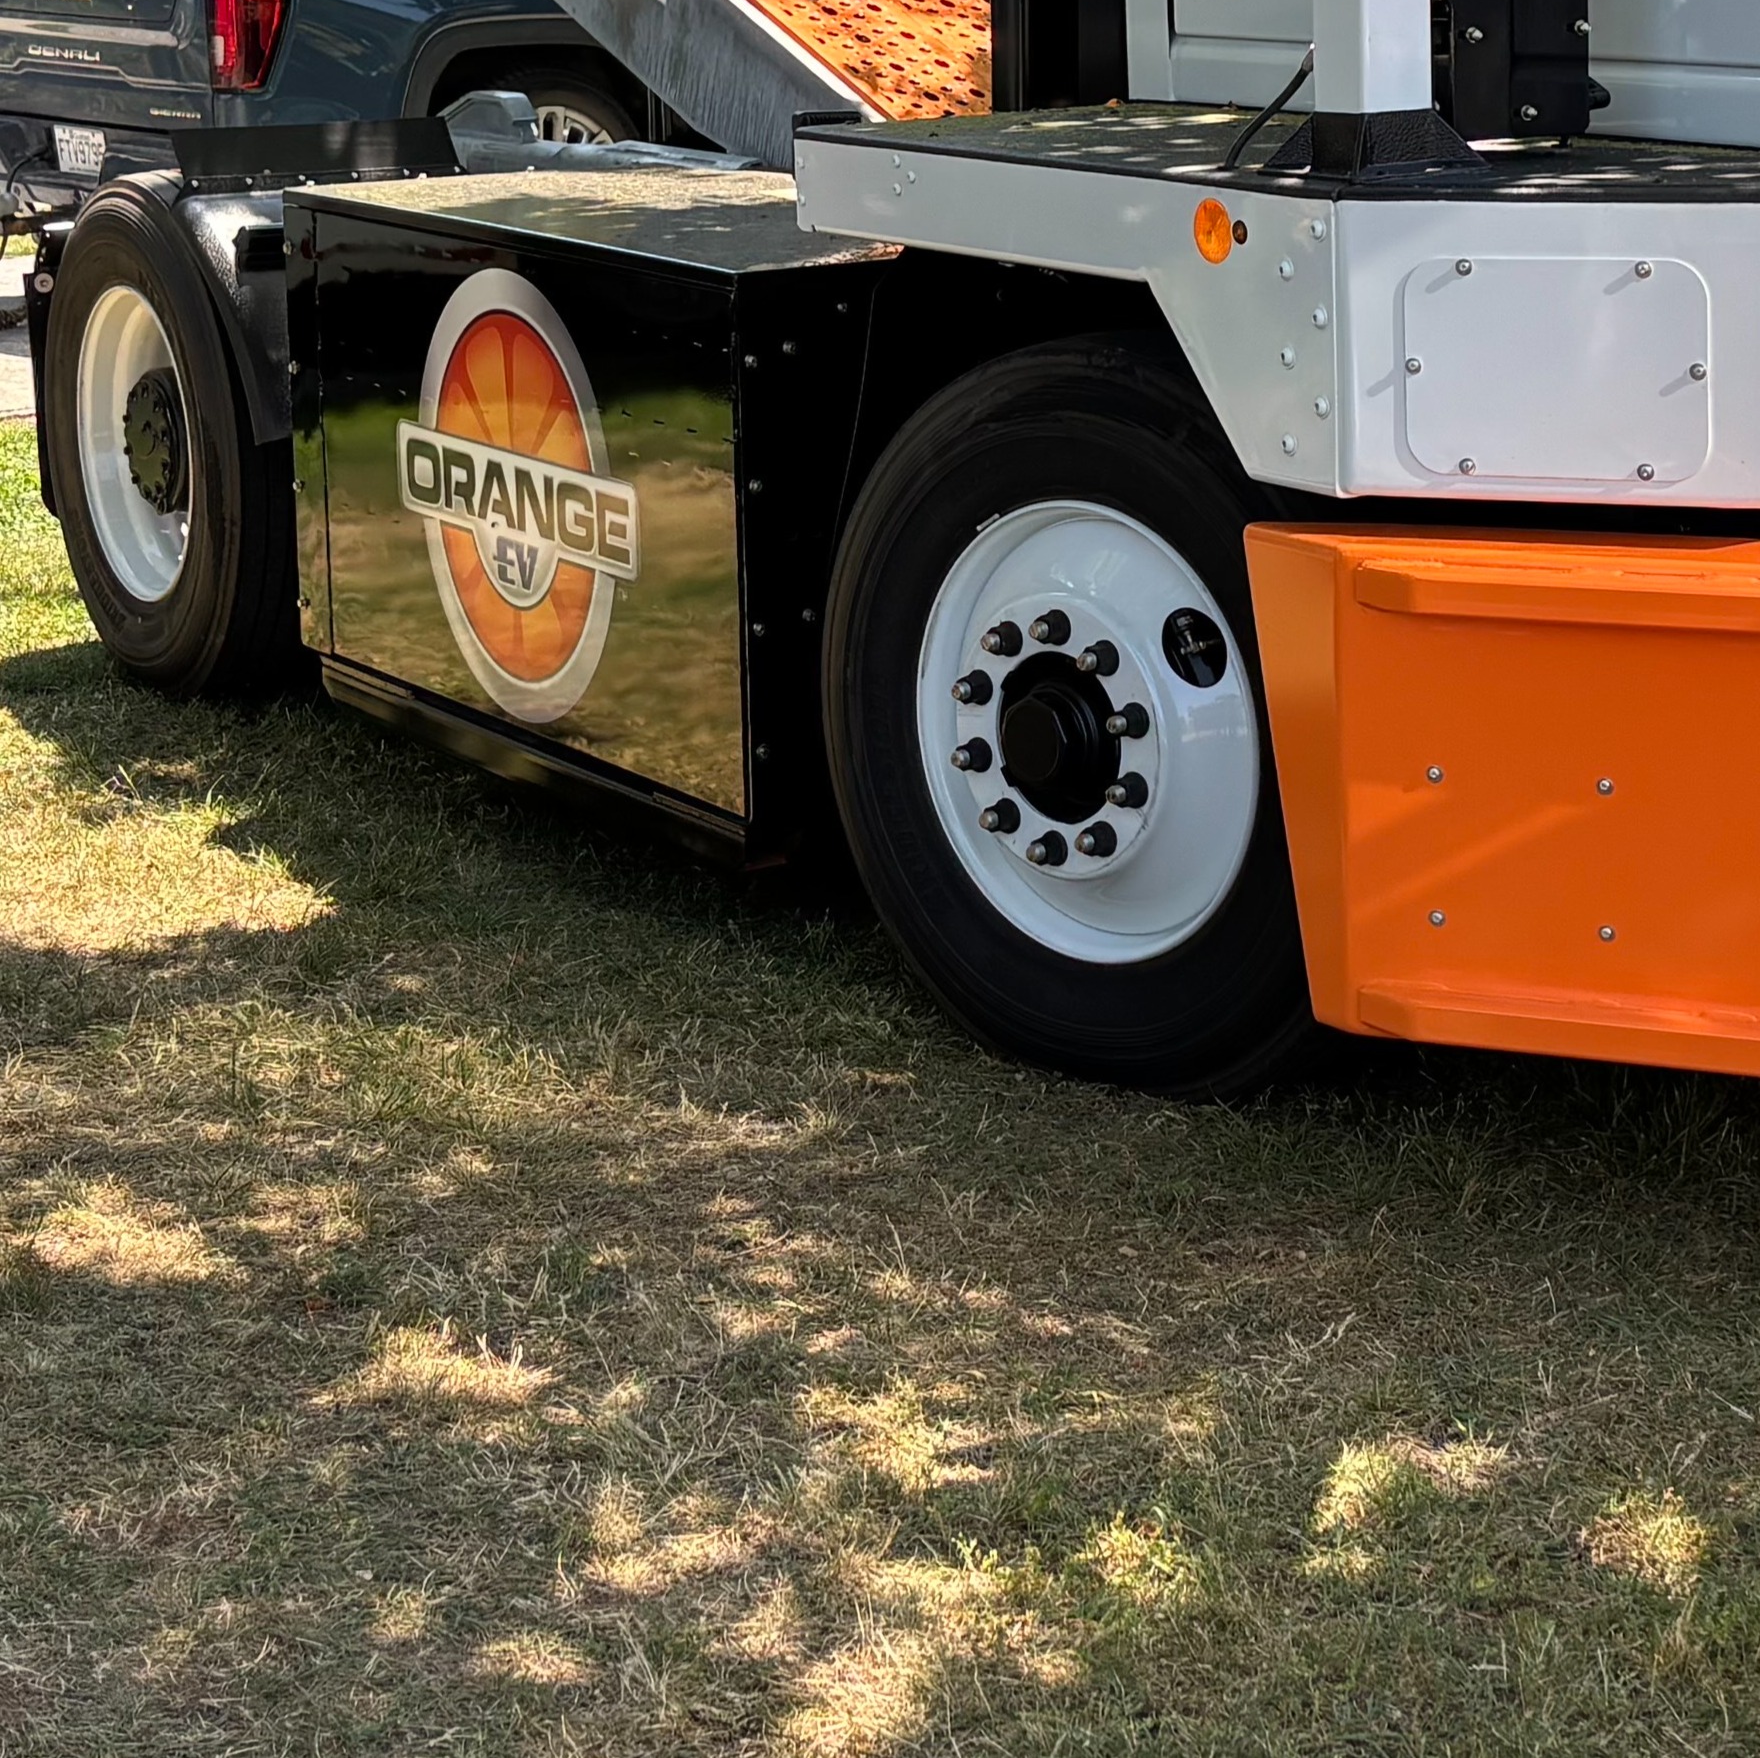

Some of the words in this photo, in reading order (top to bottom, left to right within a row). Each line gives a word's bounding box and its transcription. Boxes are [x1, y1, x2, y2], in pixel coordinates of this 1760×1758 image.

[28, 44, 100, 62] DENALI
[406, 438, 632, 566] ORANGE
[493, 535, 539, 591] EV
